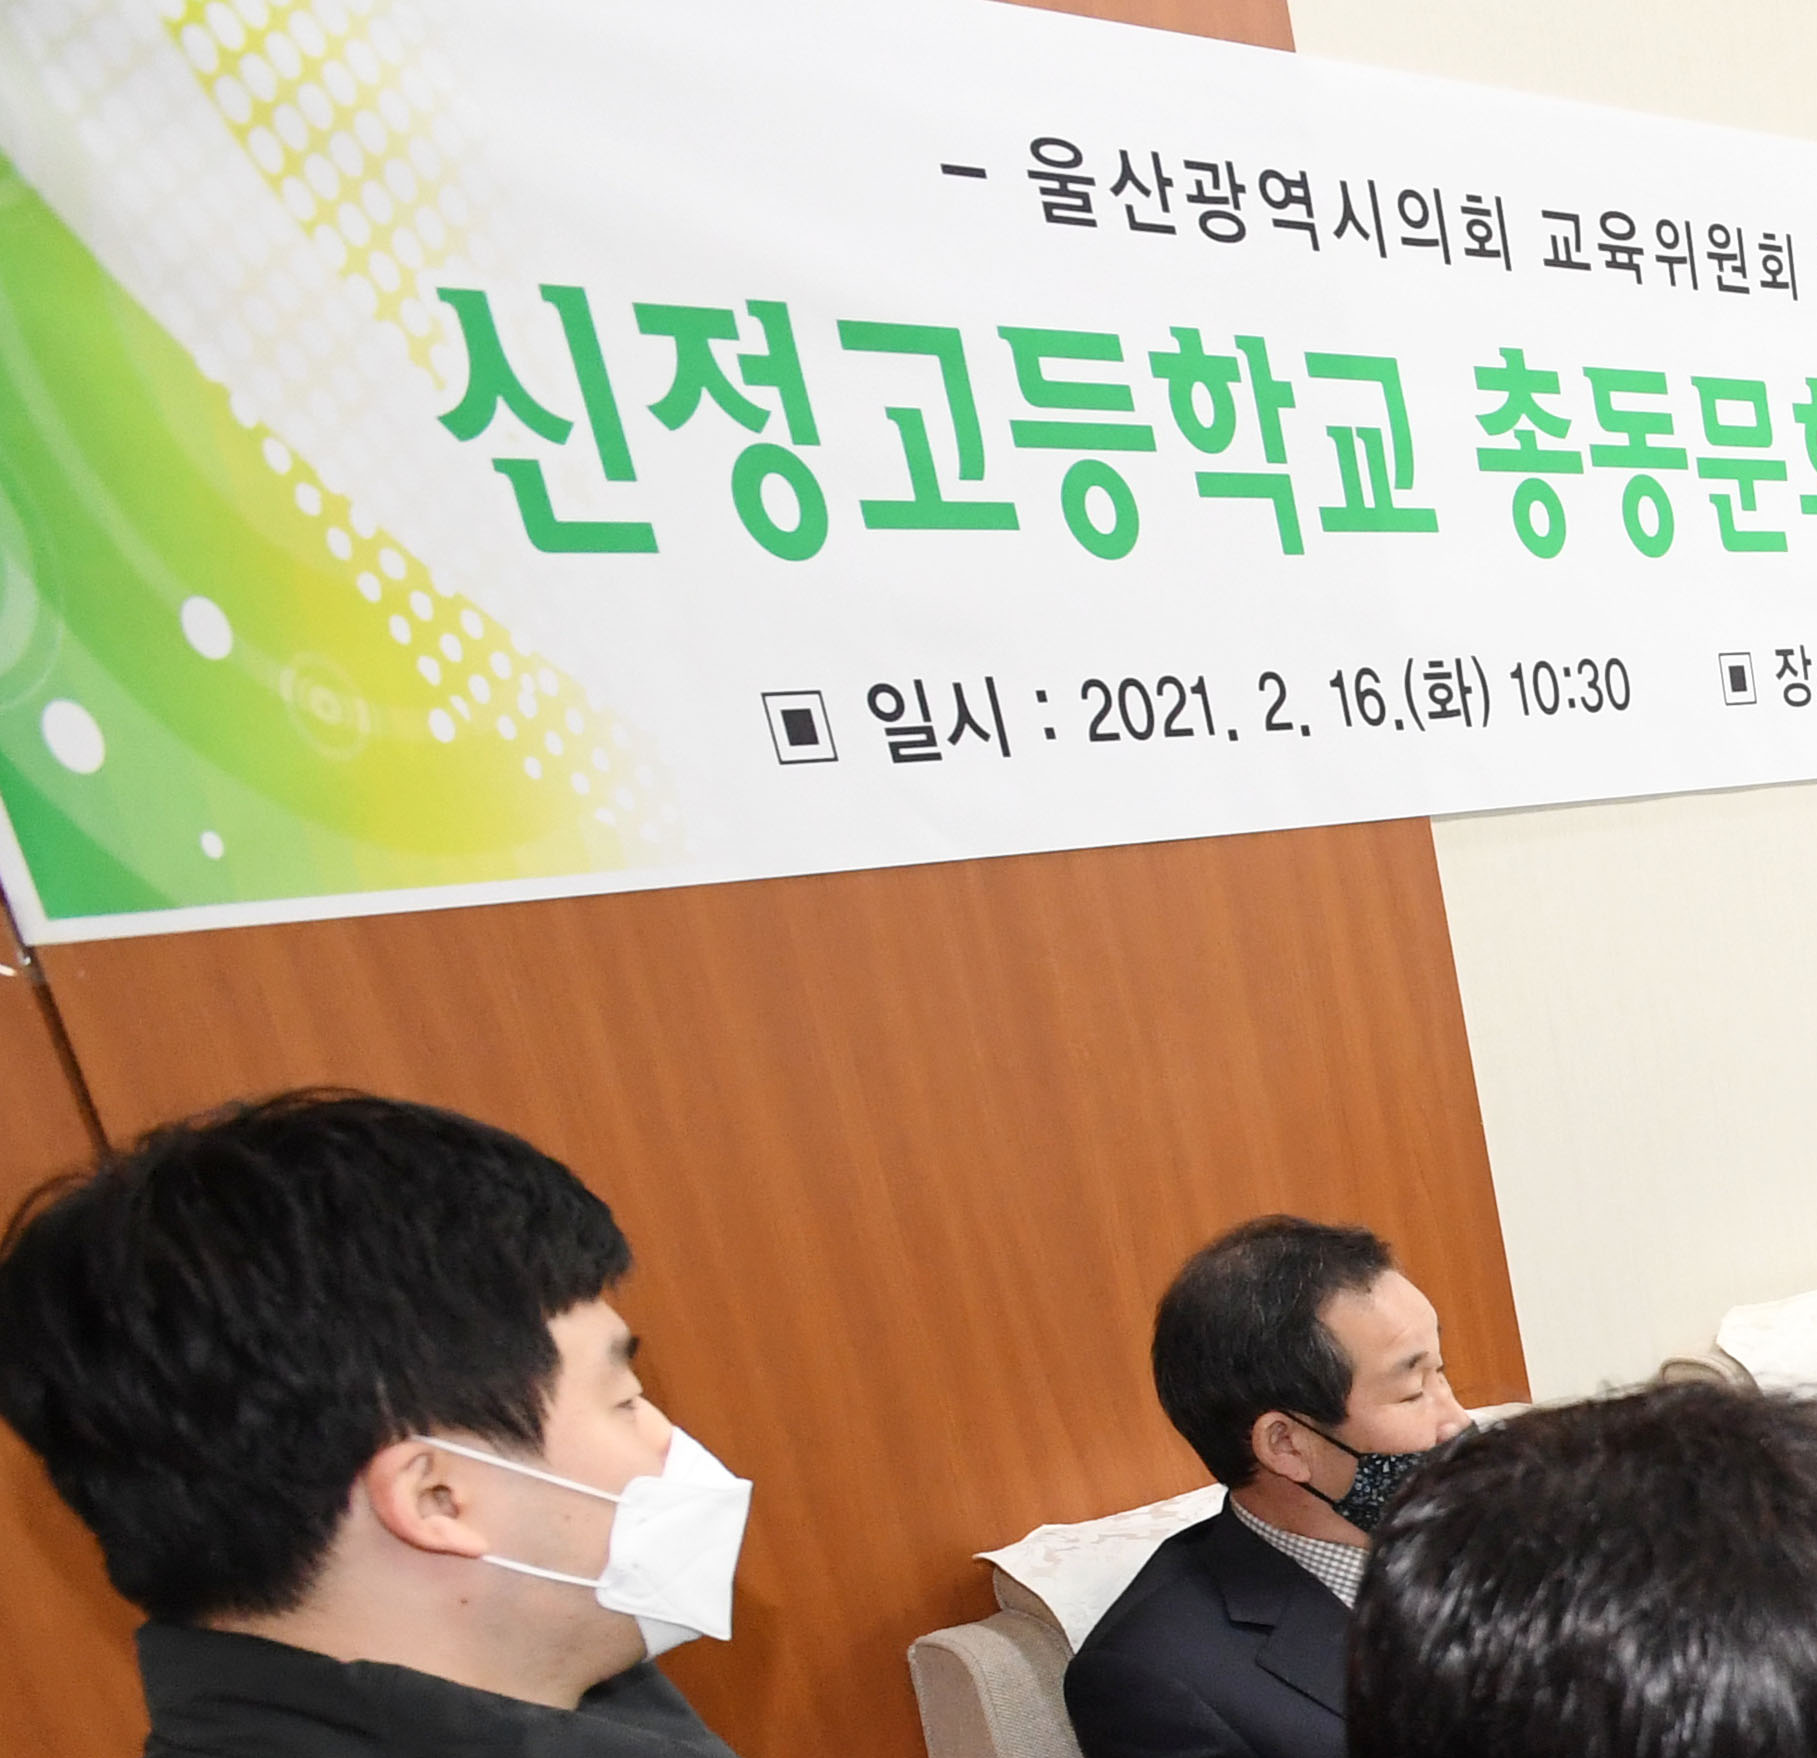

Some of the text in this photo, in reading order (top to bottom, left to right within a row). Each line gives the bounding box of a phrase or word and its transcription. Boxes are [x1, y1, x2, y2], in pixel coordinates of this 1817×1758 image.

[1027, 137, 1512, 271] 울산광역시의회
[1542, 210, 1798, 301] 교육위원회
[436, 283, 1439, 563] 신정고등학교
[867, 676, 1011, 763] 일시
[1081, 676, 1238, 742] 2021.
[1259, 671, 1310, 736] 2.
[1510, 658, 1630, 716] 10:30
